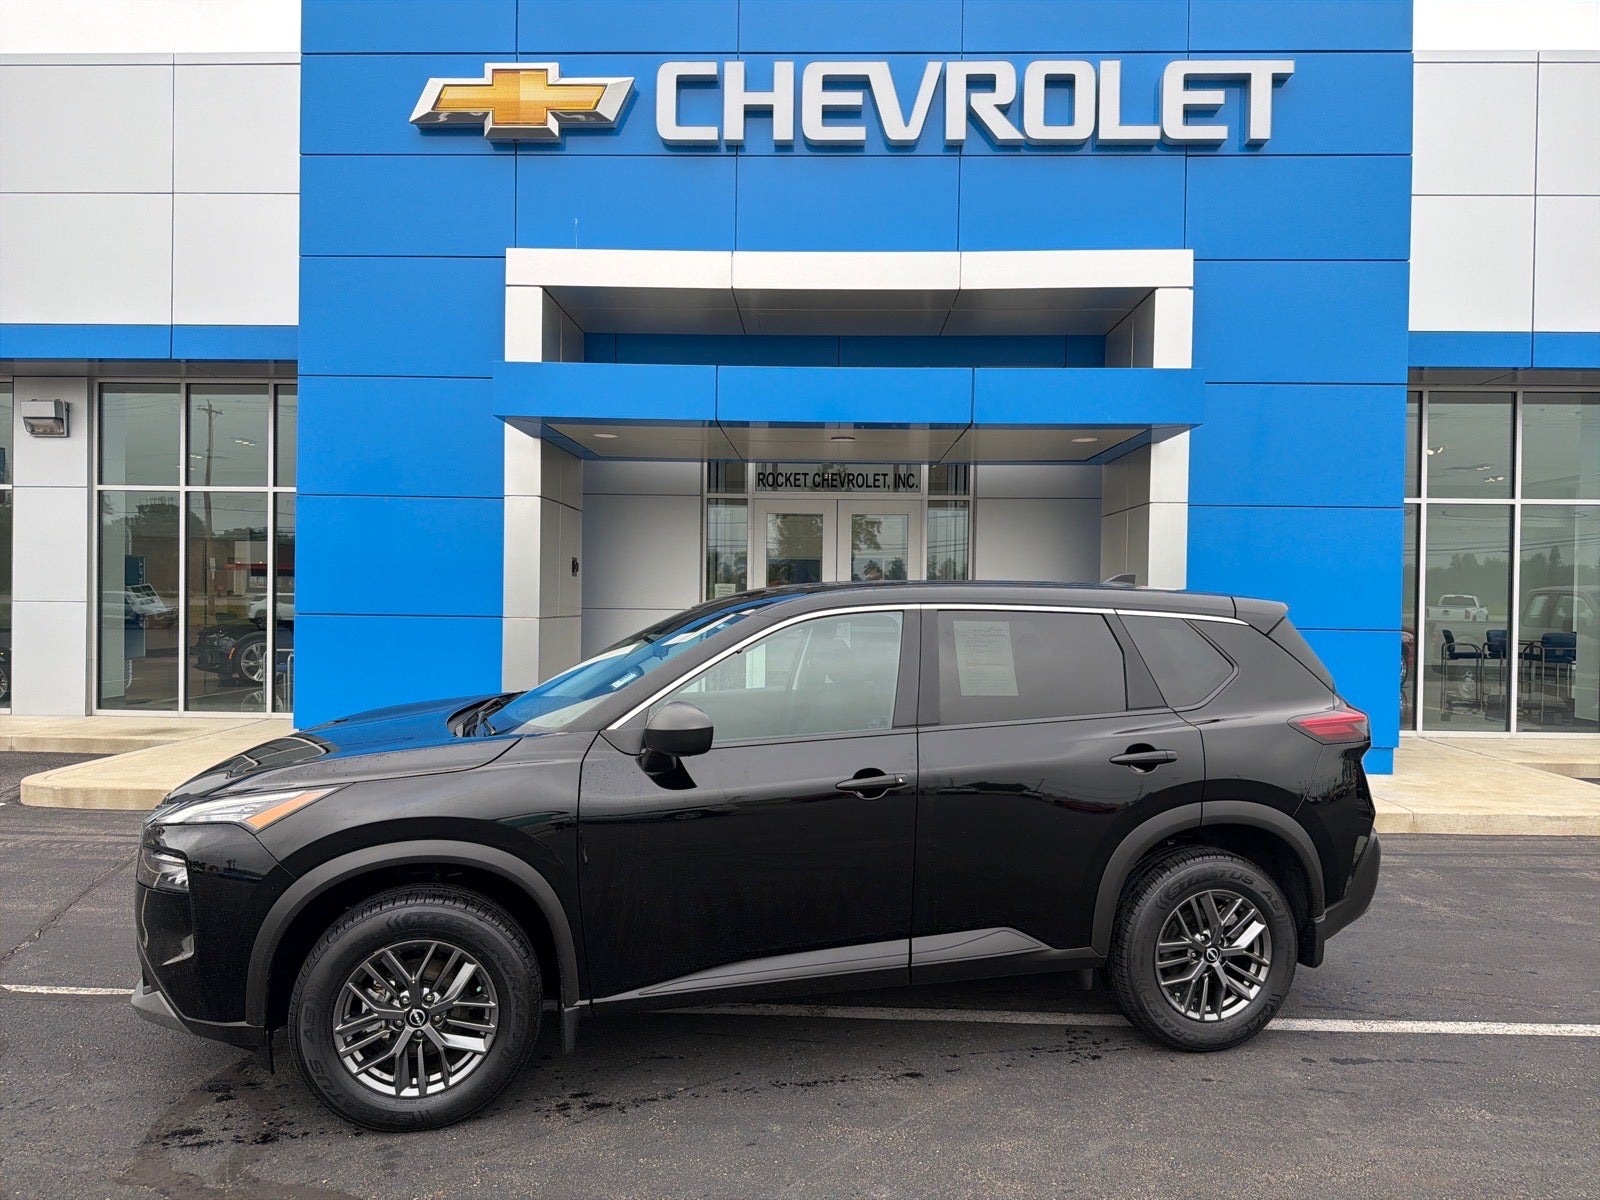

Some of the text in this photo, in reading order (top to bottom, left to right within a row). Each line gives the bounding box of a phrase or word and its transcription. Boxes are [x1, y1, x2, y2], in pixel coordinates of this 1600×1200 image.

[656, 60, 1295, 145] CHEVROLET
[758, 472, 919, 490] ROCKET CHEVROLET, INC.
